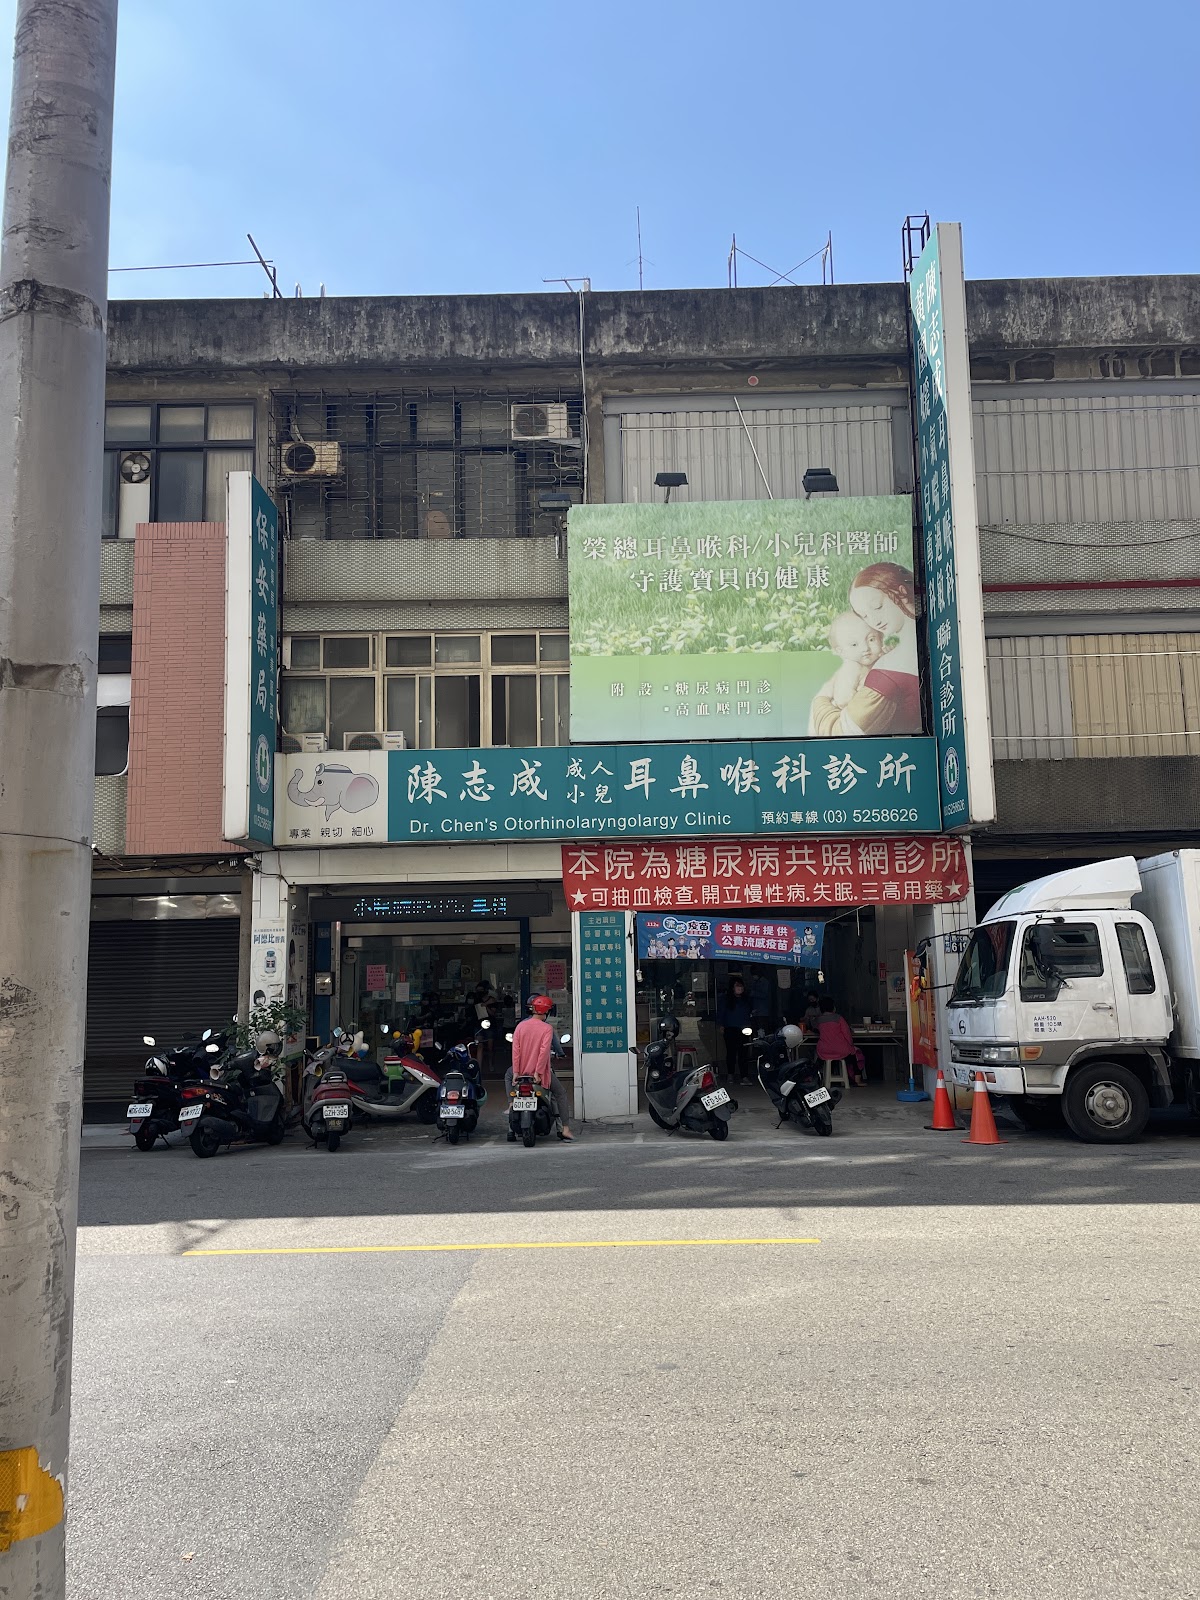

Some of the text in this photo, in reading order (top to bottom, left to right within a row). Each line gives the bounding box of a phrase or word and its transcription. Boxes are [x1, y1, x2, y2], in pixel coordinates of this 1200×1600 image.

[582, 530, 899, 561] 榮總耳鼻喉科/小兒科醫師
[629, 564, 831, 594] 守護寶貝的健康
[610, 680, 772, 698] 附設 糖尿病門診
[936, 618, 956, 740] 聯合診所
[674, 700, 772, 717] 高血壓門診
[407, 752, 918, 805] 陳志成 成人 耳鼻喉科診所
[566, 784, 613, 805] 小兒
[410, 812, 732, 834] Dr. Chen's Otorhinolaryngolargy Clinic
[761, 808, 919, 825] 預約專線 (03) 5258626
[320, 827, 343, 838] 親切
[351, 826, 374, 837] 細心
[568, 840, 961, 881] 本院為糖尿病共照網診所
[721, 924, 788, 937] 本院所提供
[721, 935, 788, 951] 公費流感疫苗
